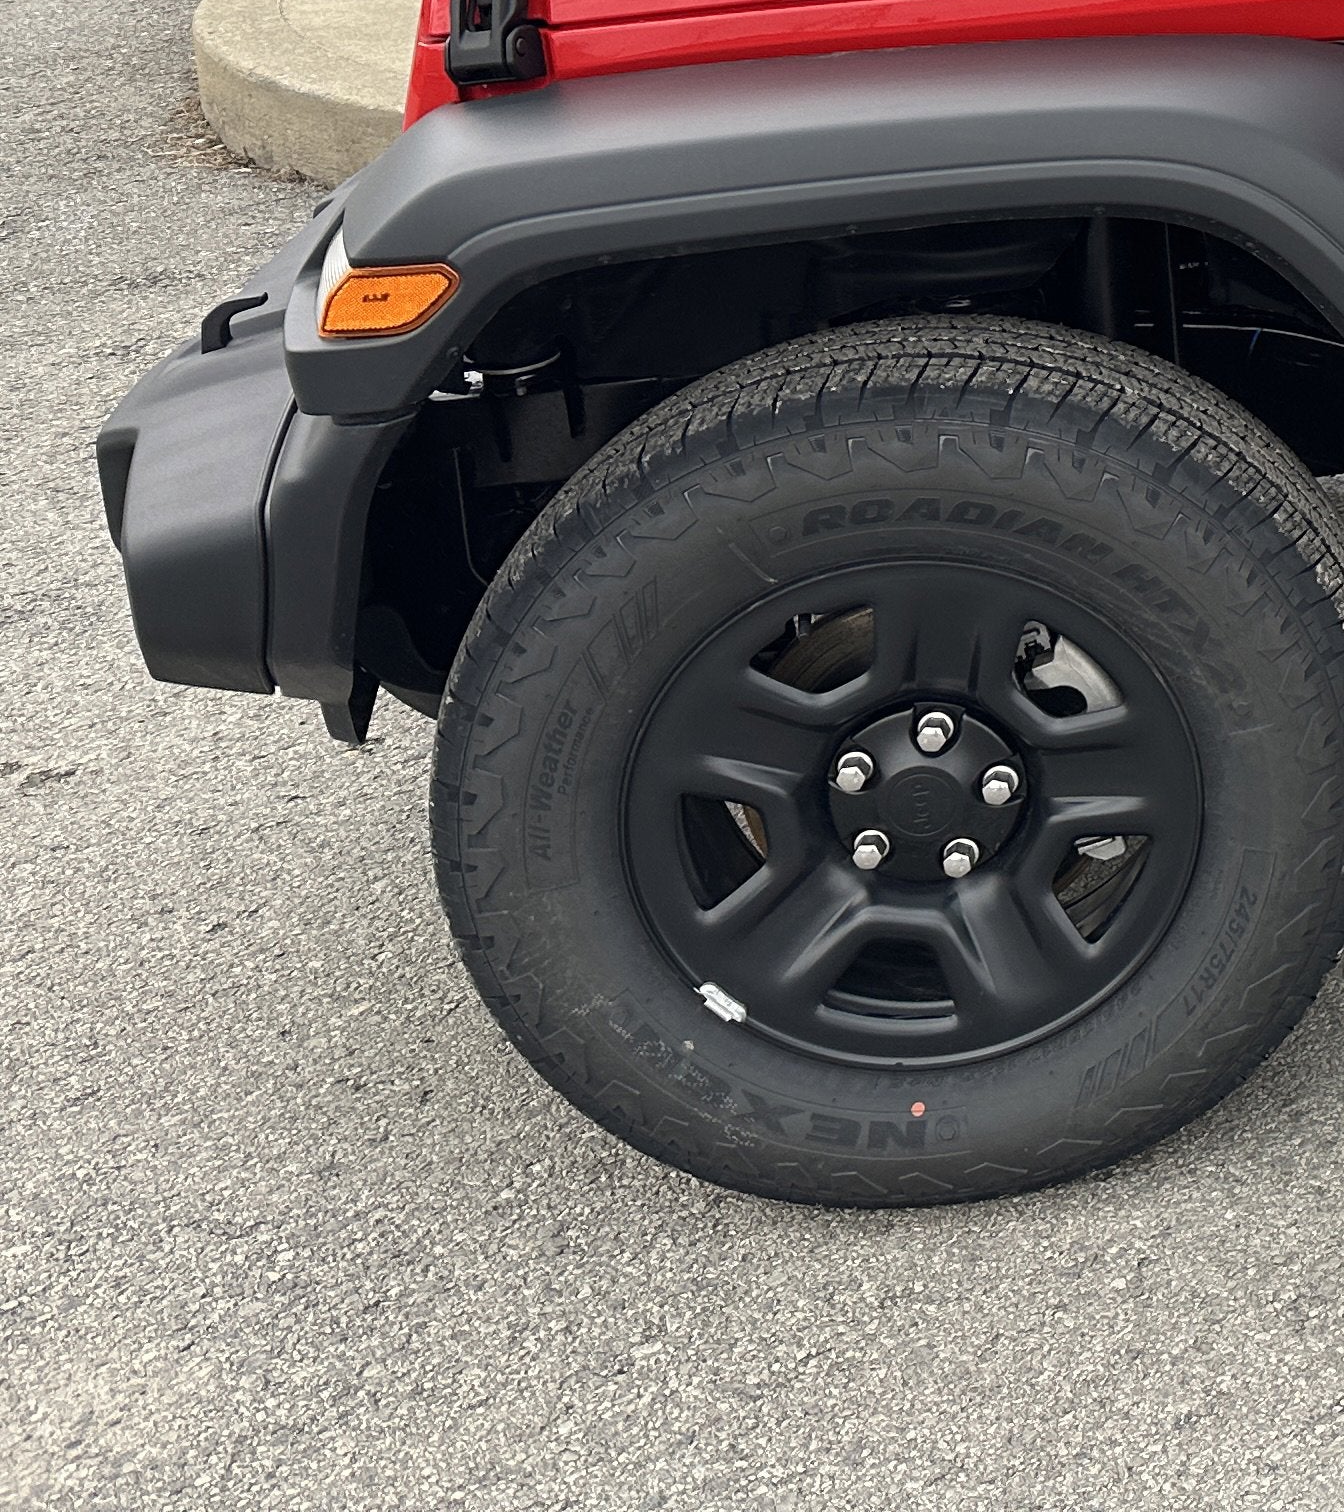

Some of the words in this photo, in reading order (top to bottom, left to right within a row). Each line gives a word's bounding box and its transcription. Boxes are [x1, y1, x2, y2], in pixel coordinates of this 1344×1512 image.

[801, 496, 1114, 566] ROADIAN
[527, 698, 578, 861] All-Weather
[557, 707, 594, 796] Performance
[1182, 886, 1258, 1017] 245/75R17
